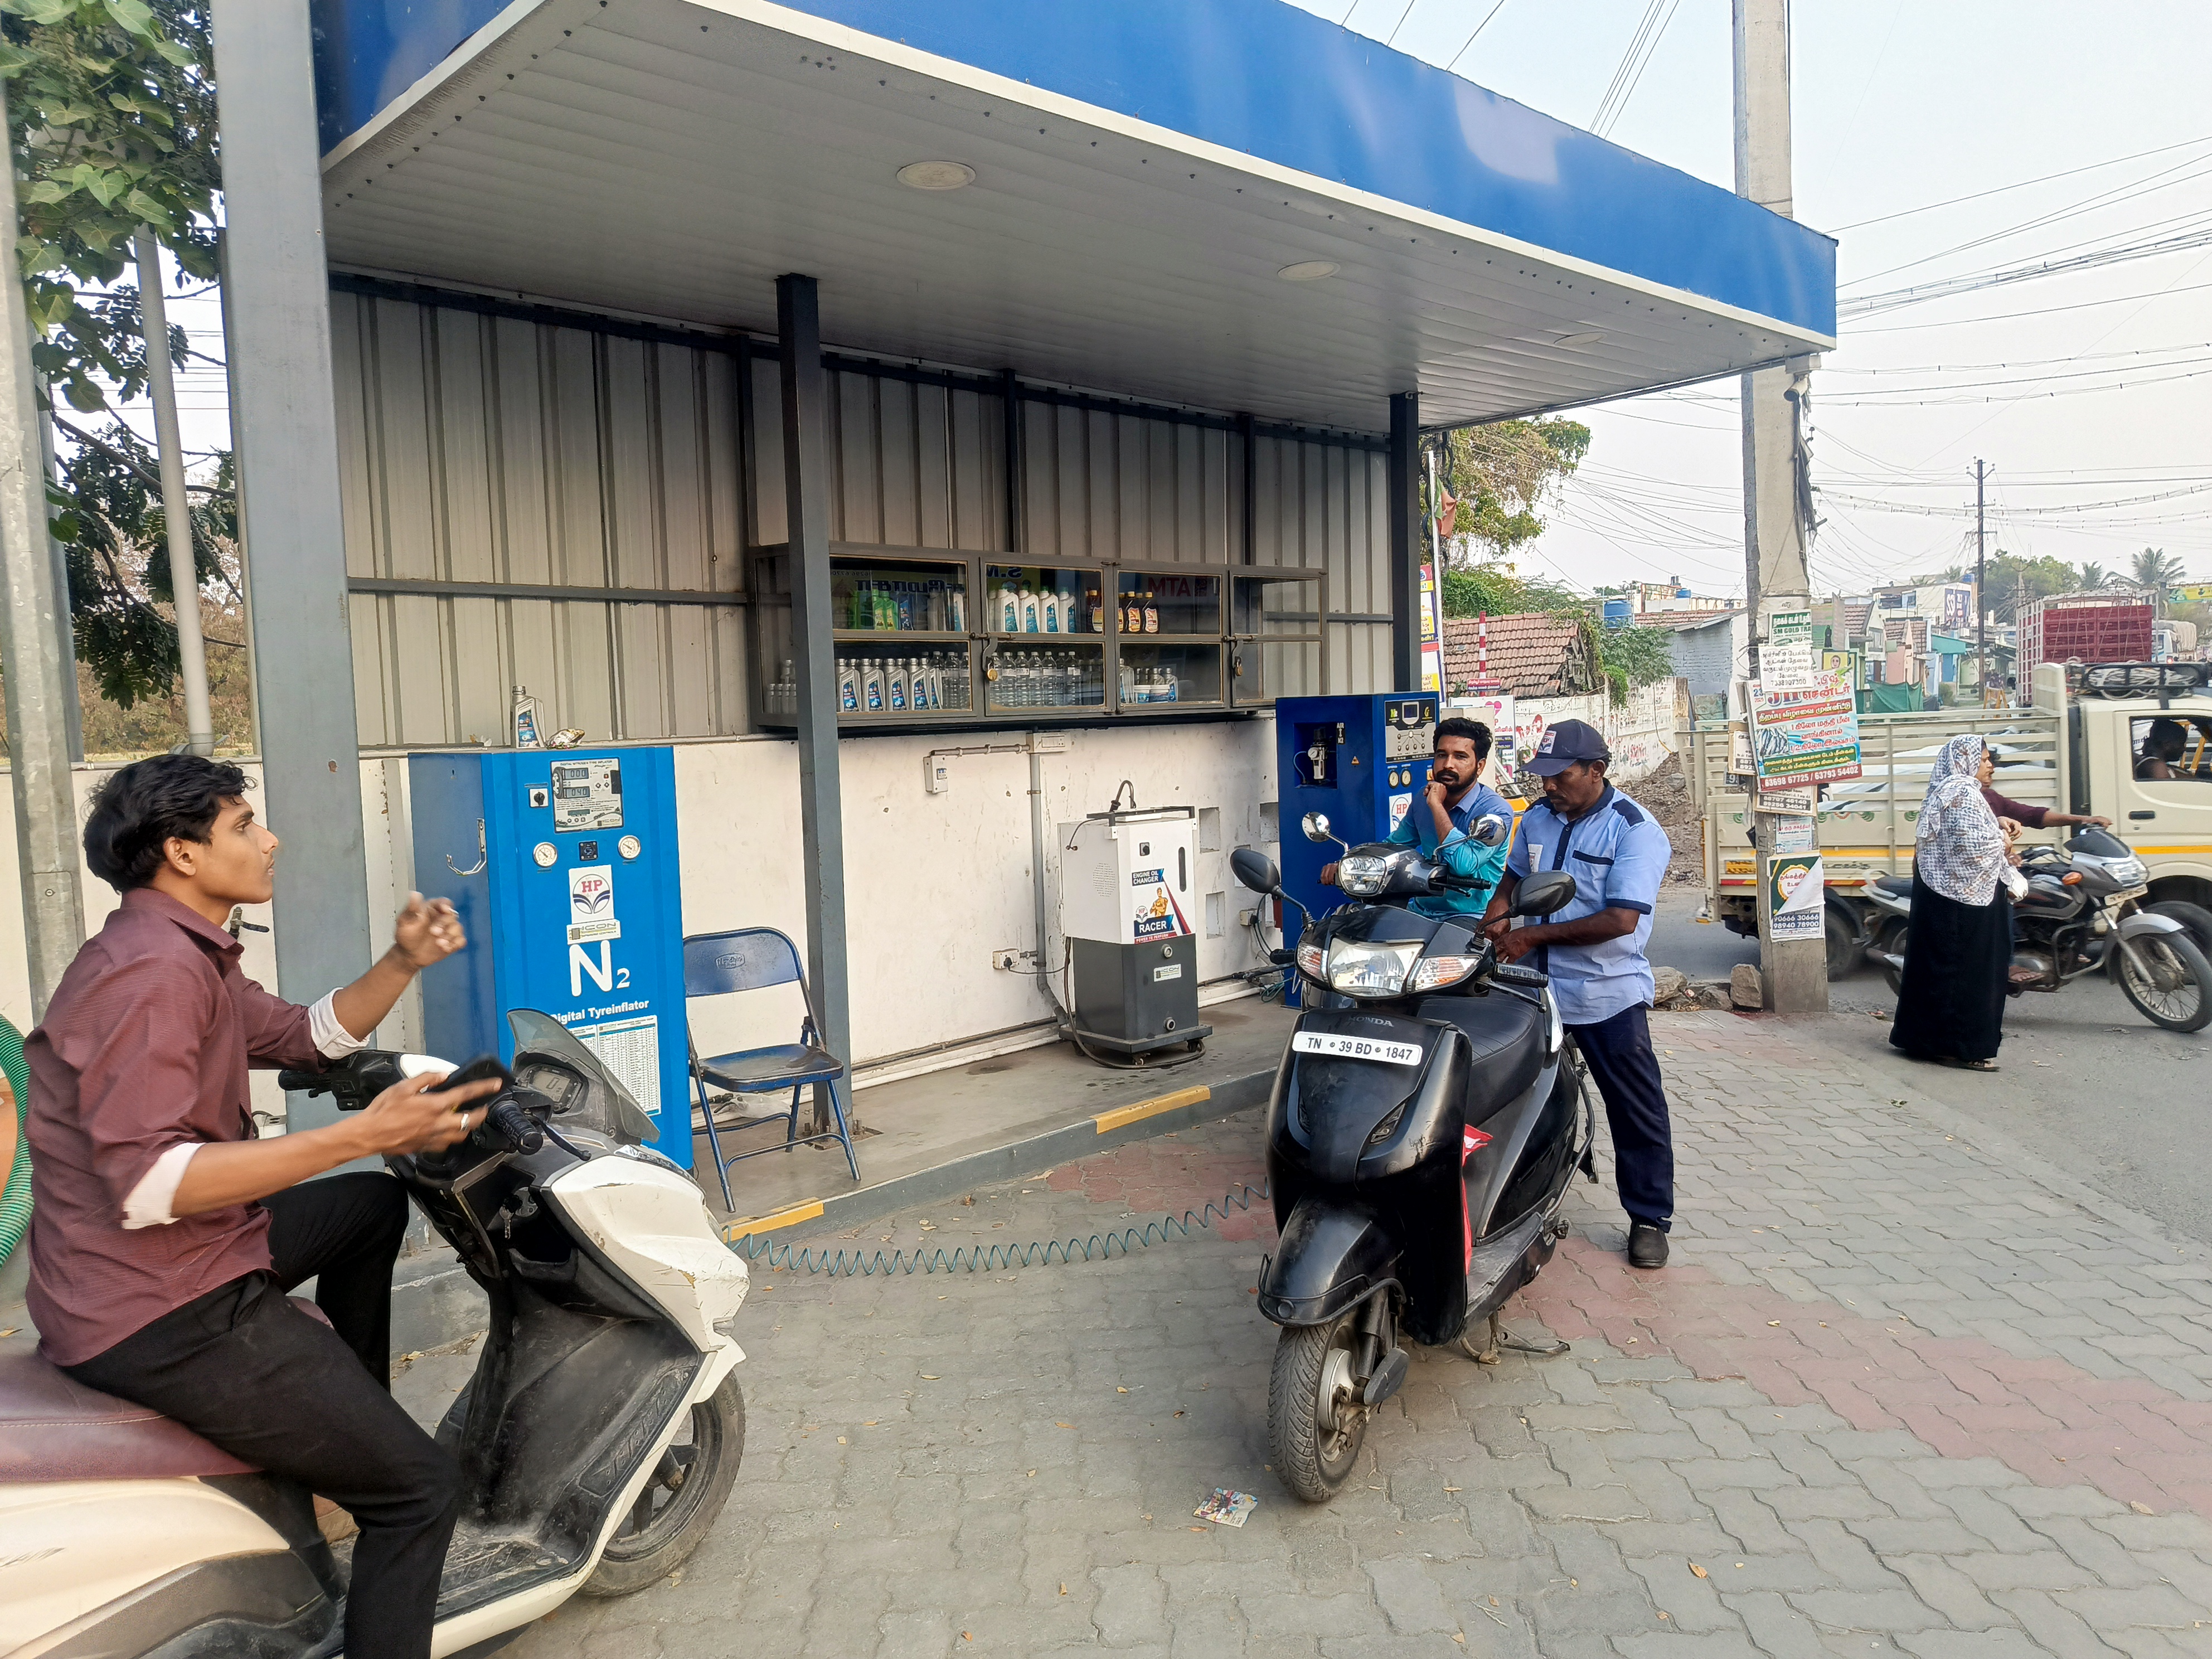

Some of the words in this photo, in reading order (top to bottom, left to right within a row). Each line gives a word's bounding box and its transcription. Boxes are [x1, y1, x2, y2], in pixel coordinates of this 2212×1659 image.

[1765, 777, 1786, 787] 63698
[1788, 774, 1809, 784] 67725
[1815, 770, 1836, 780] 63793
[1838, 766, 1859, 777] 54402
[1396, 803, 1408, 814] HP
[581, 879, 603, 893] HP
[1133, 876, 1159, 885] CHANGER
[1139, 920, 1167, 933] RACER
[588, 1000, 649, 1020] Tyreinflator
[1307, 1037, 1322, 1049] TN
[1338, 1041, 1352, 1053] 39
[1355, 1043, 1372, 1055] BD
[1386, 1046, 1413, 1060] 1847
